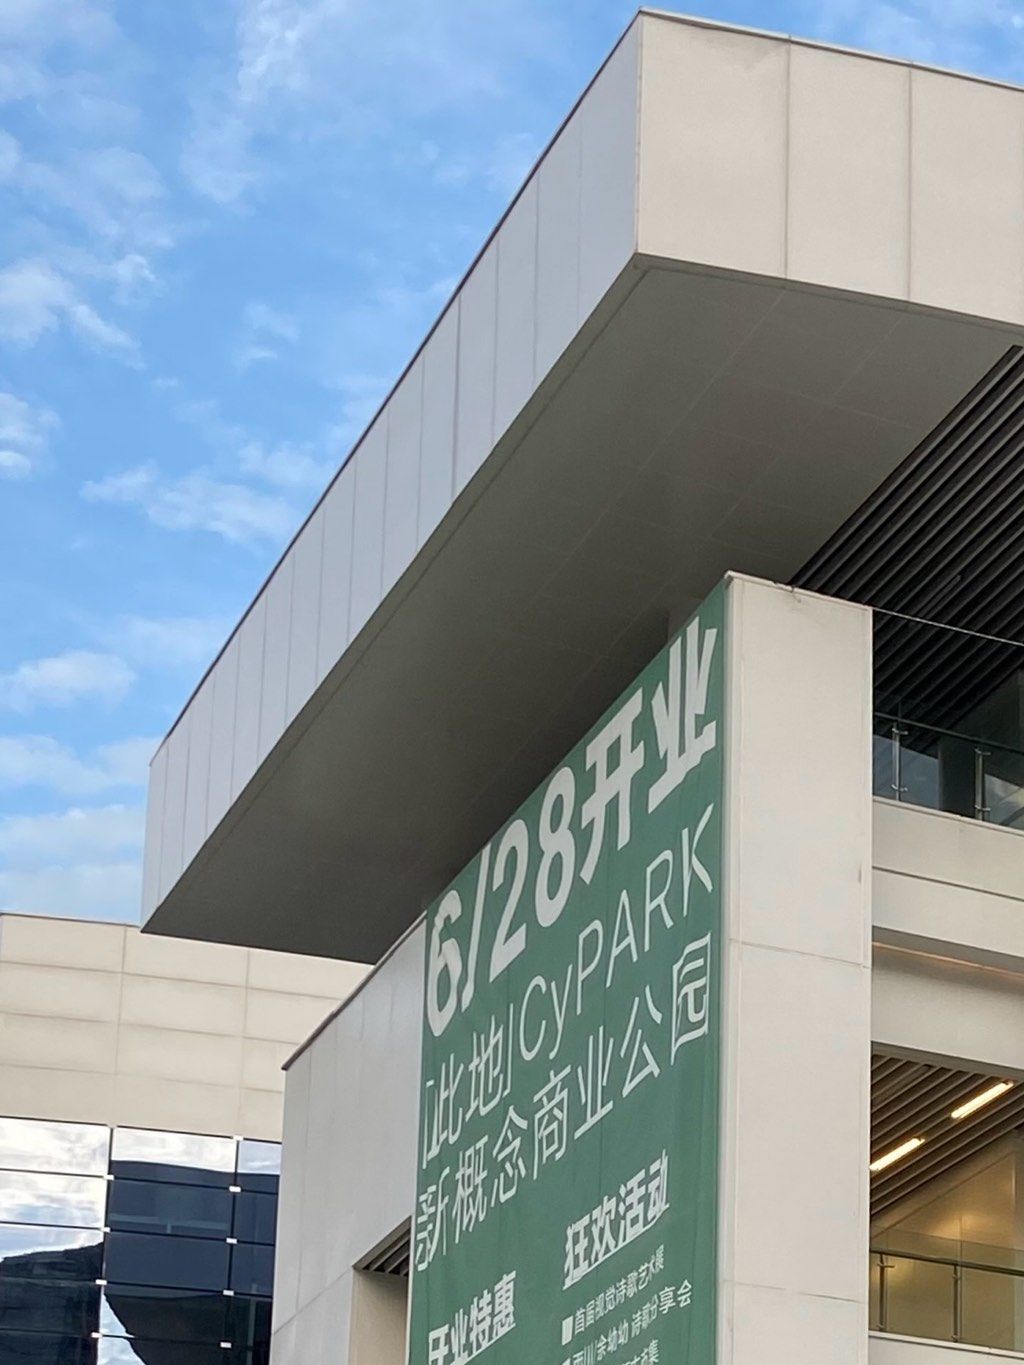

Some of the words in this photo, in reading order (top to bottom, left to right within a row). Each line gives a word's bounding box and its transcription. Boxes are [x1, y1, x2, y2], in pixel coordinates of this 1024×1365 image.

[427, 616, 717, 1037] 6/28开业
[415, 932, 711, 1272] 新概念商业公园
[564, 1149, 669, 1288] 狂欢活动
